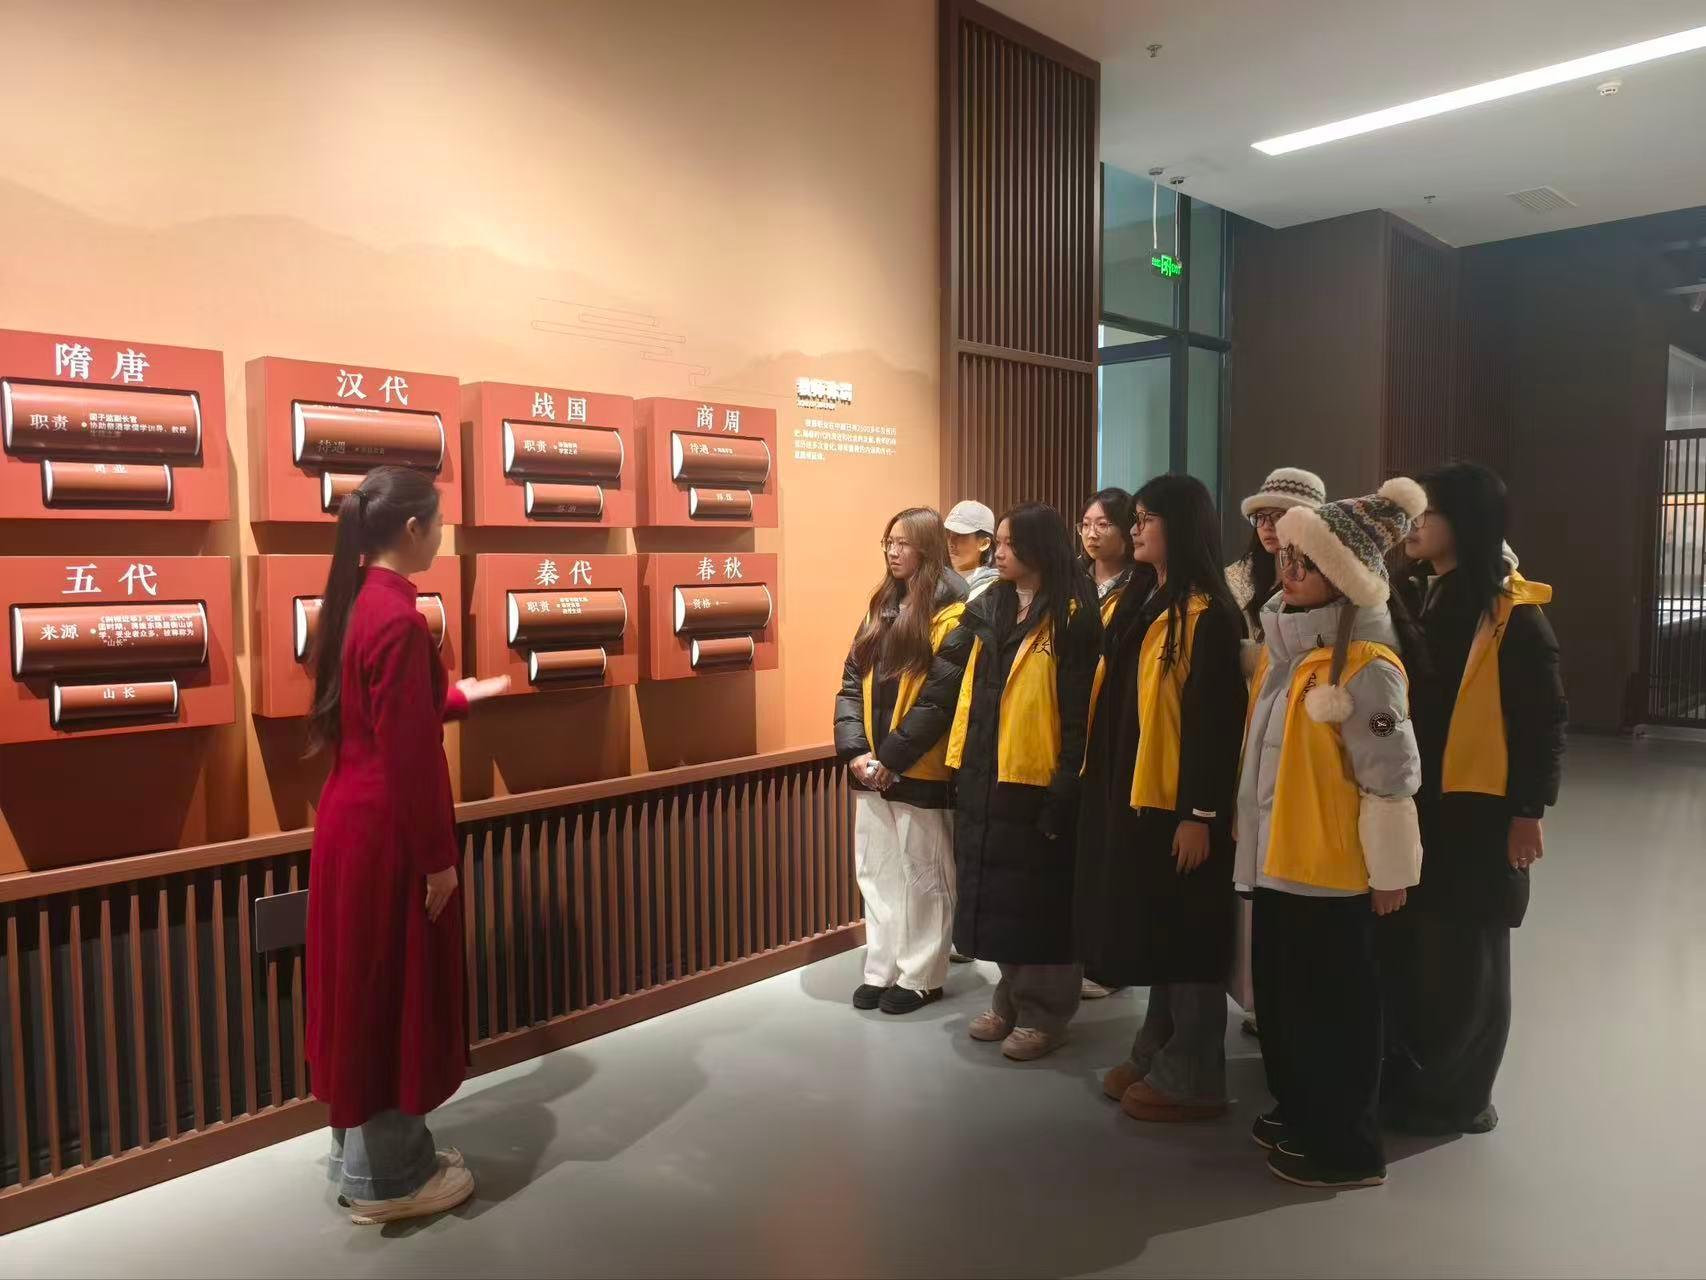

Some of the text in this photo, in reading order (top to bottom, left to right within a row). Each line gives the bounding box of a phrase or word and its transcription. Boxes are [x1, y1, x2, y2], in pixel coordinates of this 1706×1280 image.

[54, 342, 150, 383] 隋唐
[336, 369, 408, 405] 汉代
[531, 391, 587, 422] 战国
[696, 404, 740, 432] 商周
[30, 413, 70, 430] 职责
[524, 439, 547, 453] 职责
[62, 563, 157, 596] 五代
[534, 559, 593, 586] 秦代
[696, 556, 743, 581] 春秋
[527, 600, 550, 613] 职责
[40, 623, 79, 641] 来源
[103, 687, 136, 700] 山长
